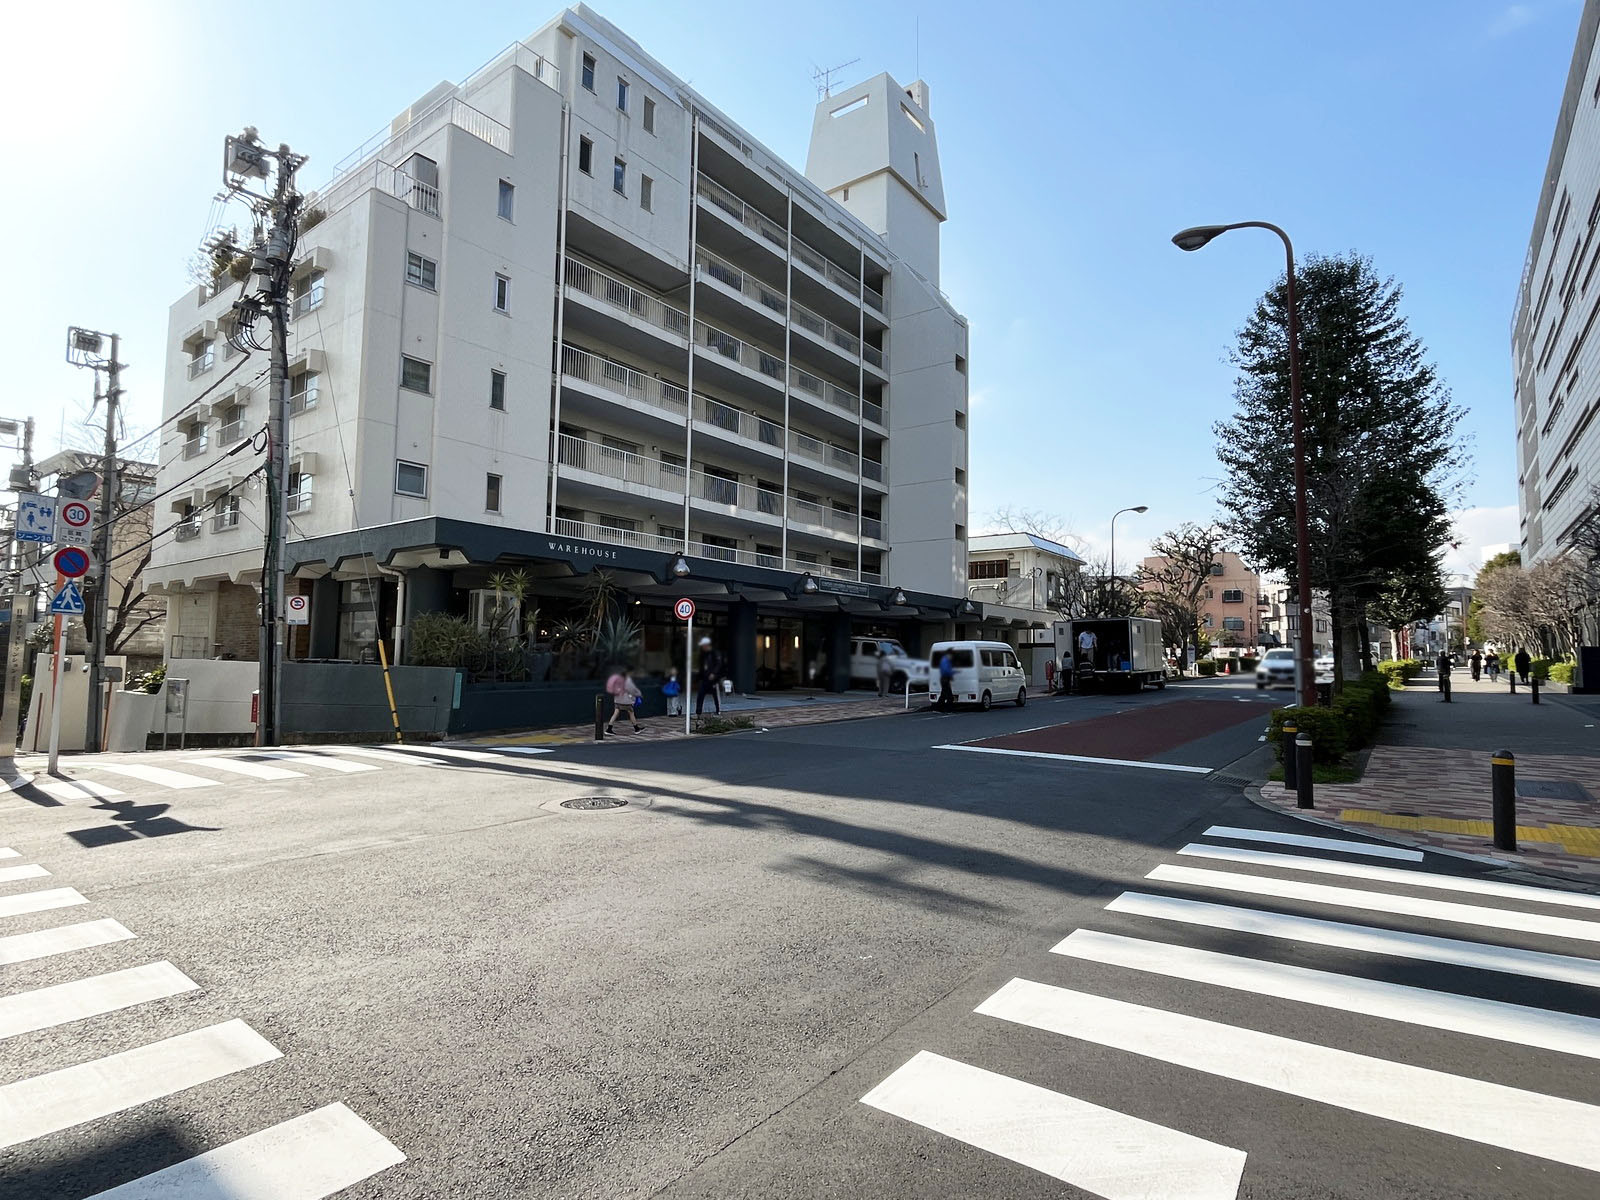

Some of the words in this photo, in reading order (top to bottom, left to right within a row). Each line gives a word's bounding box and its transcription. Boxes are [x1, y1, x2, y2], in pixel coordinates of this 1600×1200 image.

[69, 508, 85, 521] 30
[17, 533, 52, 542] ゾーン30
[548, 542, 617, 559] WAREHOUSE
[679, 604, 690, 614] 40
